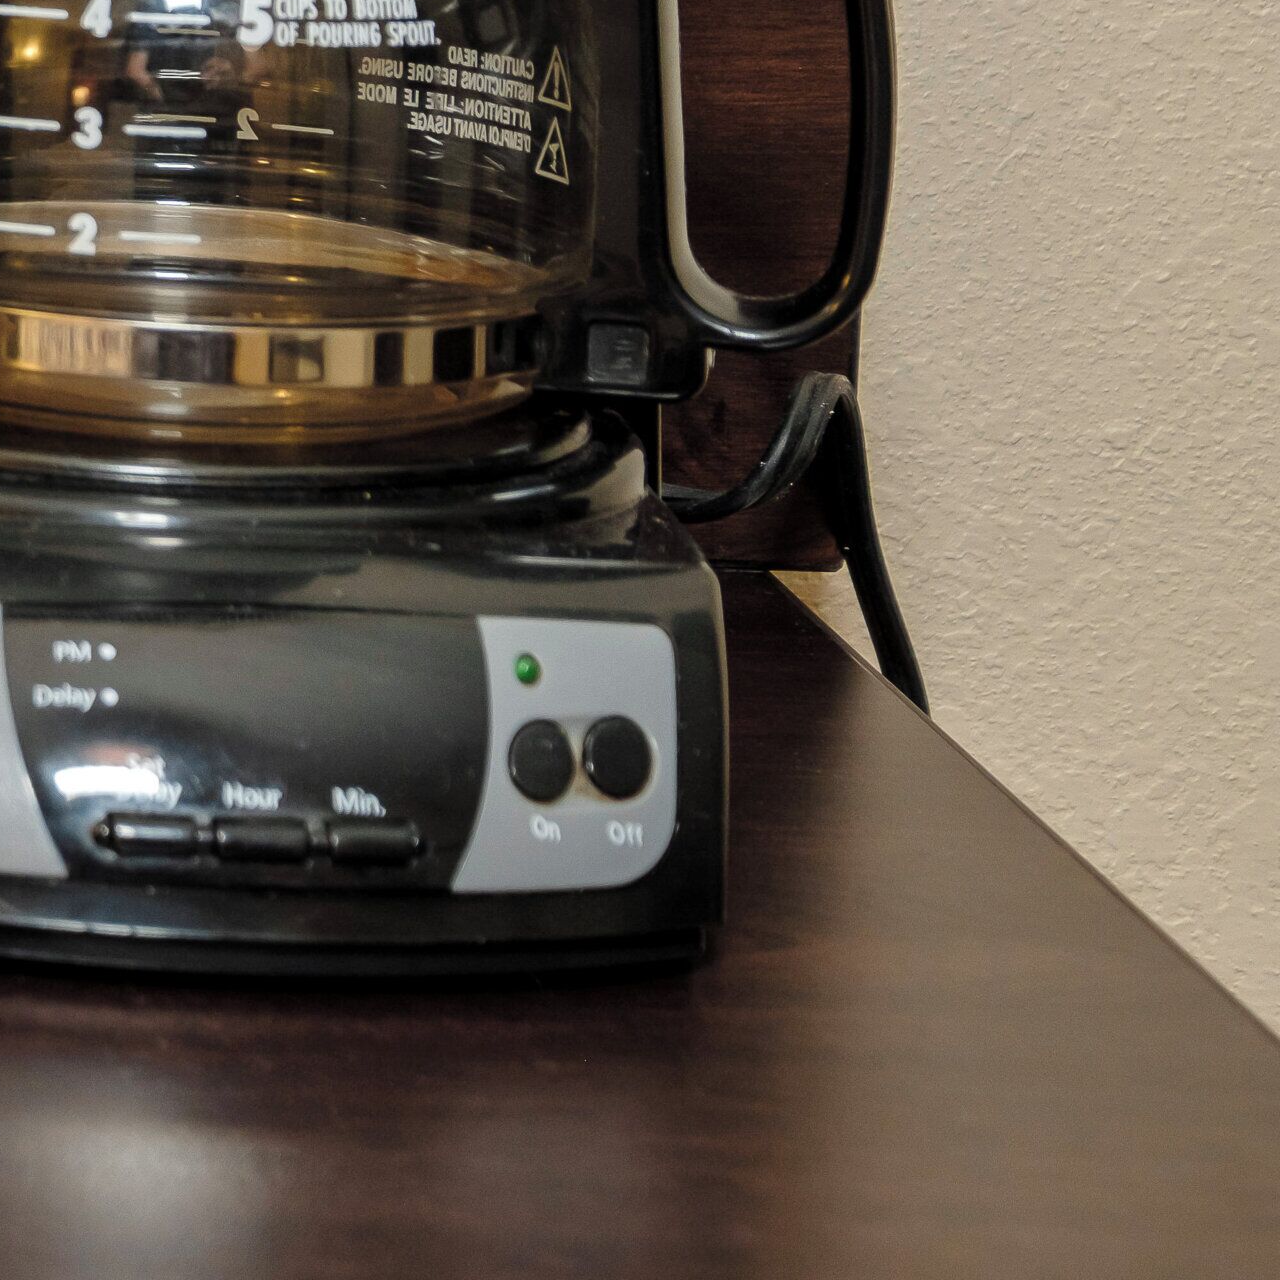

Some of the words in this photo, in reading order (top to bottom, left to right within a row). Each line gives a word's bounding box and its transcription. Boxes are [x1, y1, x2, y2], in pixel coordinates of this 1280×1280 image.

[273, 22, 300, 47] OF
[307, 22, 382, 47] POURING
[72, 106, 103, 150] 3
[68, 212, 98, 256] 2
[52, 640, 92, 663] PM
[32, 682, 97, 713] Delay
[221, 780, 284, 811] Hour
[529, 814, 562, 844] On
